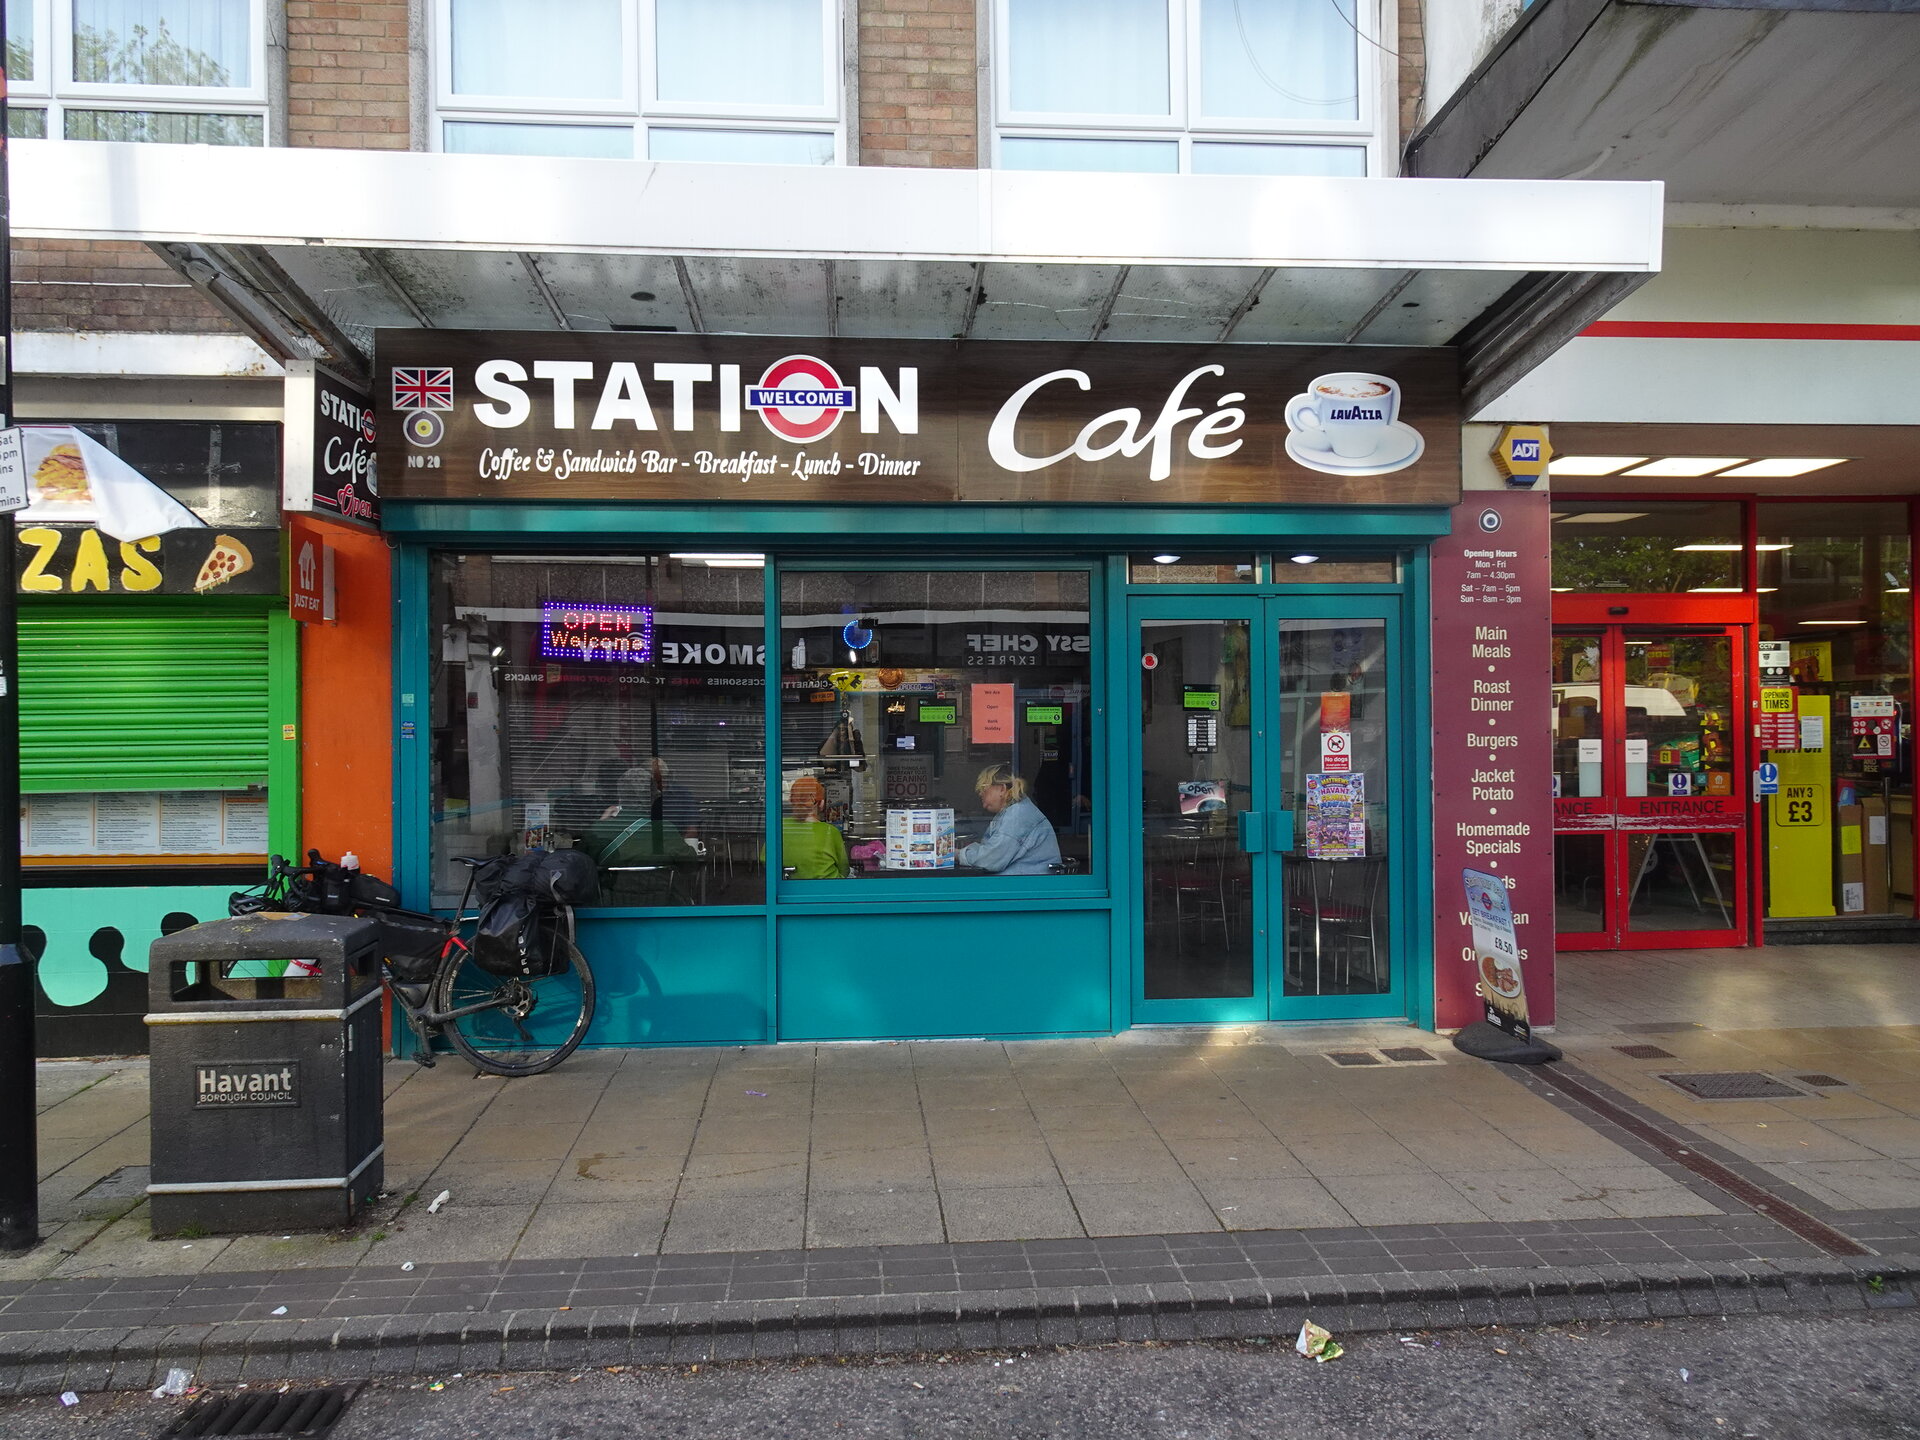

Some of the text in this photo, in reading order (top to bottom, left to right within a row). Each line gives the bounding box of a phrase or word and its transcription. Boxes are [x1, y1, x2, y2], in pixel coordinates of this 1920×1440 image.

[758, 391, 845, 405] WELCOME
[1330, 406, 1383, 421] LAVAZZA
[987, 364, 1246, 481] Café
[0, 449, 18, 461] pm
[1511, 441, 1539, 460] ADT
[324, 436, 367, 484] Café
[407, 456, 441, 468] NO 20
[479, 448, 531, 480] Coffee
[535, 448, 554, 471] &
[555, 448, 636, 480] Sandwich
[641, 450, 678, 474] Bar
[694, 451, 776, 482] Breakfast
[791, 452, 840, 481] Lunch
[858, 453, 920, 476] Dinner
[337, 484, 372, 518] Open
[1464, 550, 1517, 559] Opening Hours
[1466, 571, 1481, 579] 7am
[1490, 571, 1515, 580] 4.30pm
[1505, 585, 1520, 594] 5pm
[294, 593, 320, 611] JUST EAT
[1506, 596, 1521, 605] 3pm
[563, 611, 631, 632] OPEN
[1475, 626, 1507, 640] Main
[550, 630, 644, 651] Welcome
[1472, 644, 1511, 658] Meals
[1474, 680, 1511, 694] Roast
[1471, 698, 1514, 712] Dinner
[1764, 700, 1790, 709] TIMES
[1467, 733, 1518, 750] Burgers
[1471, 769, 1515, 782] Jacket
[1187, 784, 1216, 796] open
[1472, 787, 1514, 800] Potato
[1786, 788, 1806, 798] ANY
[1807, 787, 1813, 798] 3
[1639, 800, 1725, 815] ENTRANCE
[1788, 801, 1813, 822] £3
[1456, 822, 1531, 836] Homemade
[1466, 840, 1521, 857] Specials
[1495, 937, 1513, 955] £8.50
[200, 1068, 292, 1093] Havant
[200, 1092, 292, 1102] BOROUGH COUNCIL
